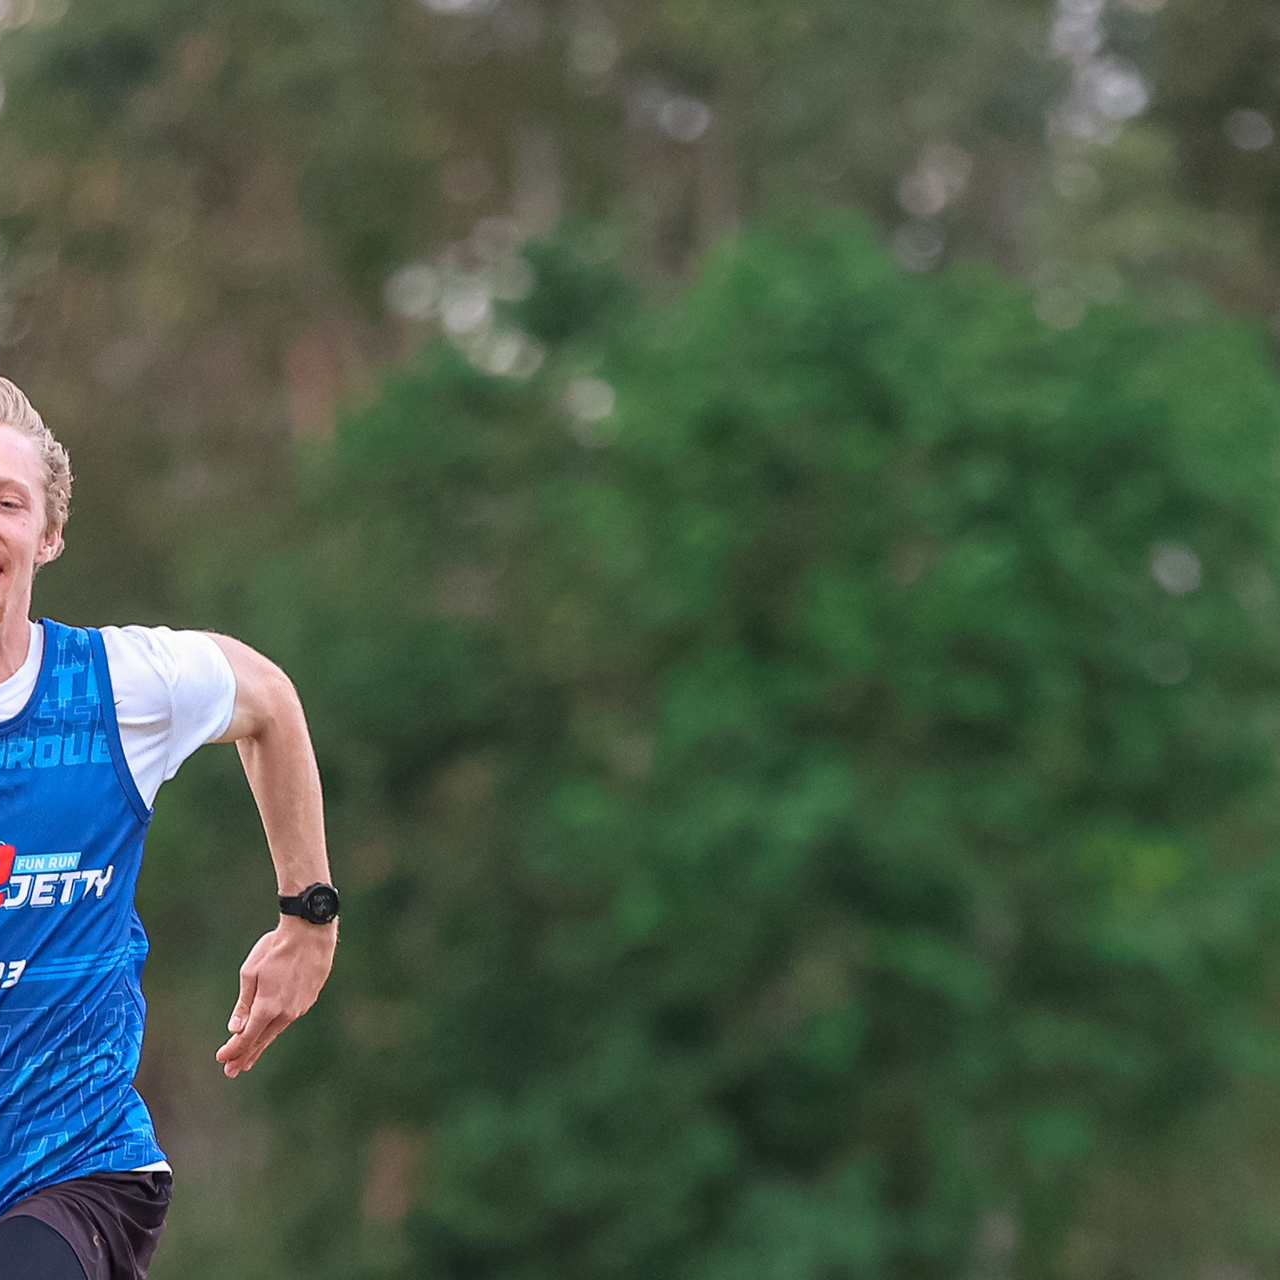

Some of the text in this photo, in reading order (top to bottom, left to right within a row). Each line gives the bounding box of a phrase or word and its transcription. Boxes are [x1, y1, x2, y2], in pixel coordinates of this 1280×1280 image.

[17, 855, 77, 871] FUN RUN
[3, 865, 114, 909] JETTY
